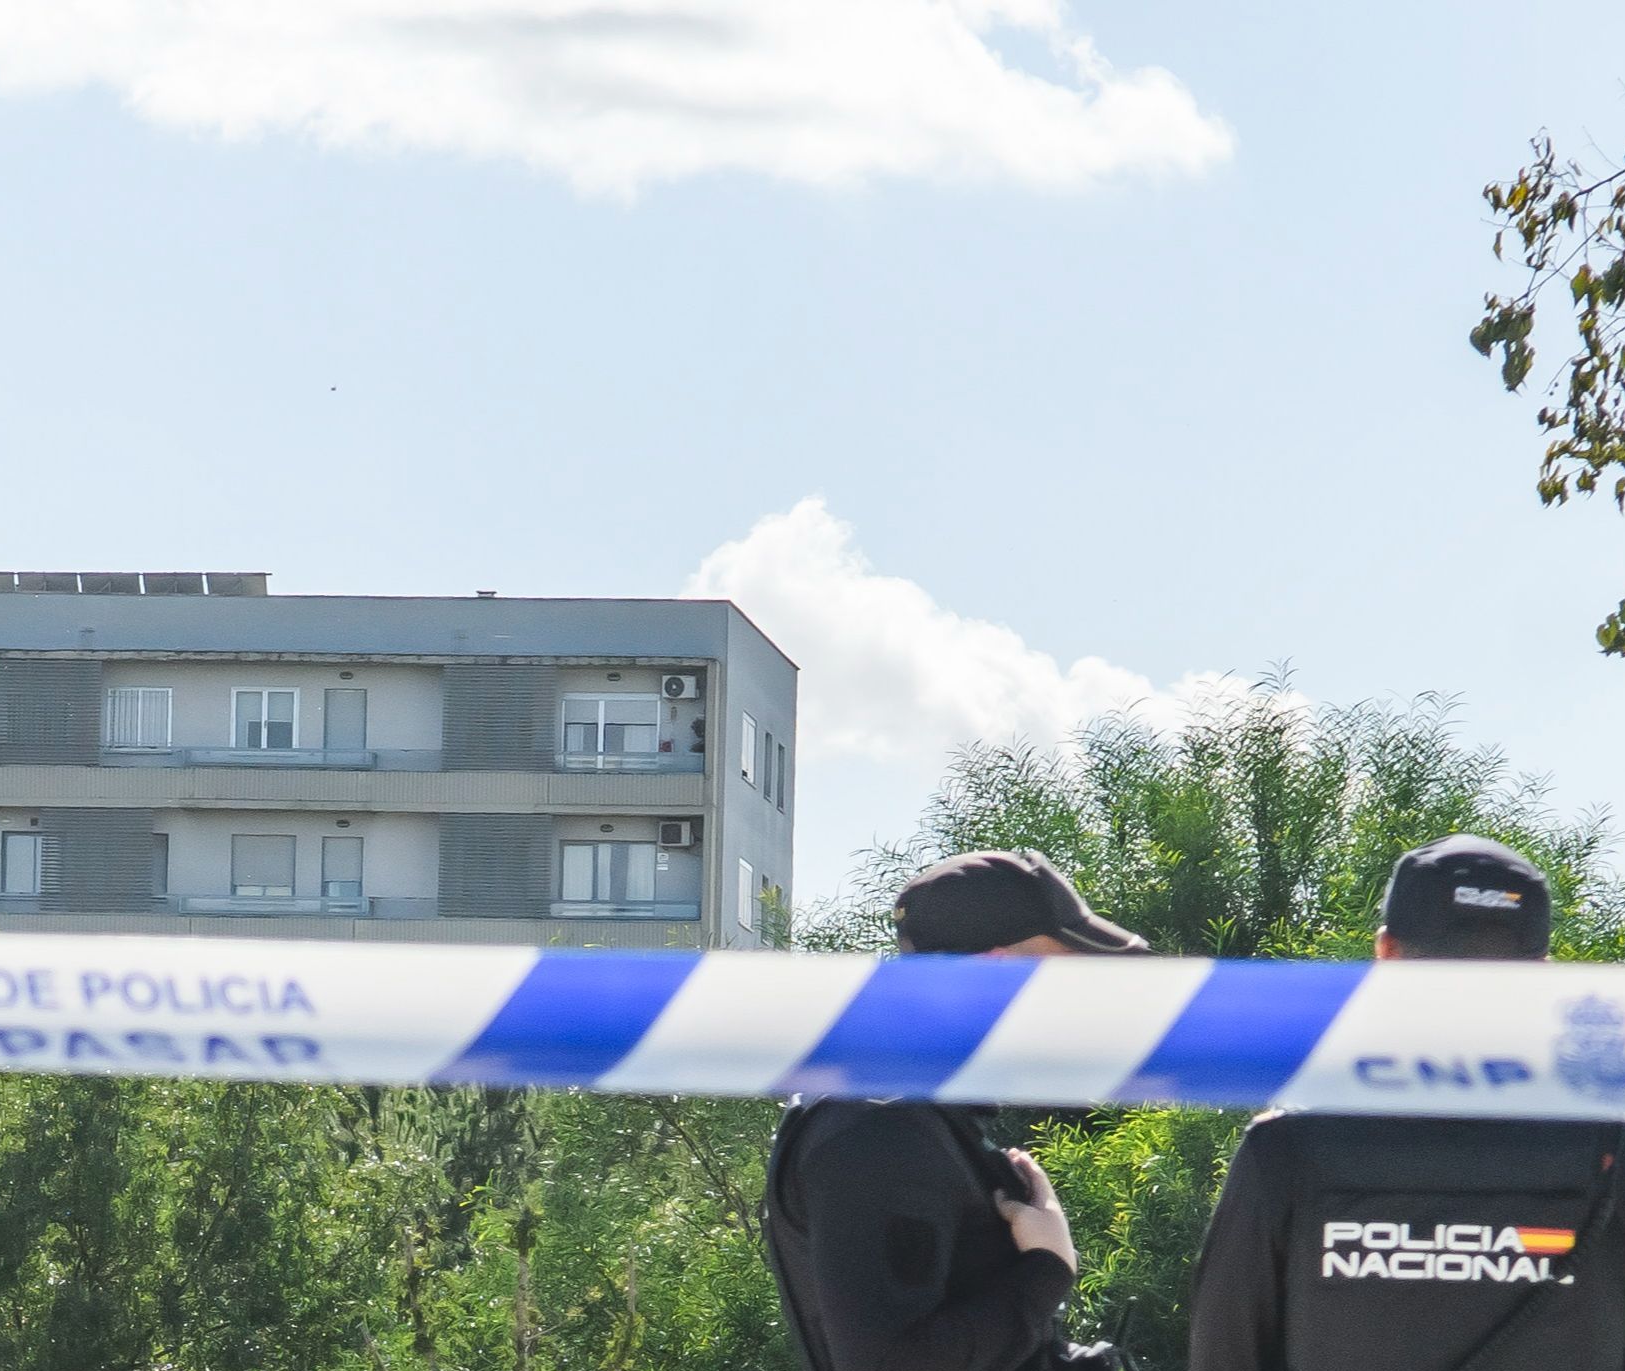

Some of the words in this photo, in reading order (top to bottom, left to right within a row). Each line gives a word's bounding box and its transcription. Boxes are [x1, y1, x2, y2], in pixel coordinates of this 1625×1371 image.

[79, 970, 318, 1016] POLICIA
[1355, 1056, 1533, 1089] CNP
[1324, 1222, 1525, 1253] POLICIA
[1322, 1251, 1575, 1285] NACIONAL
